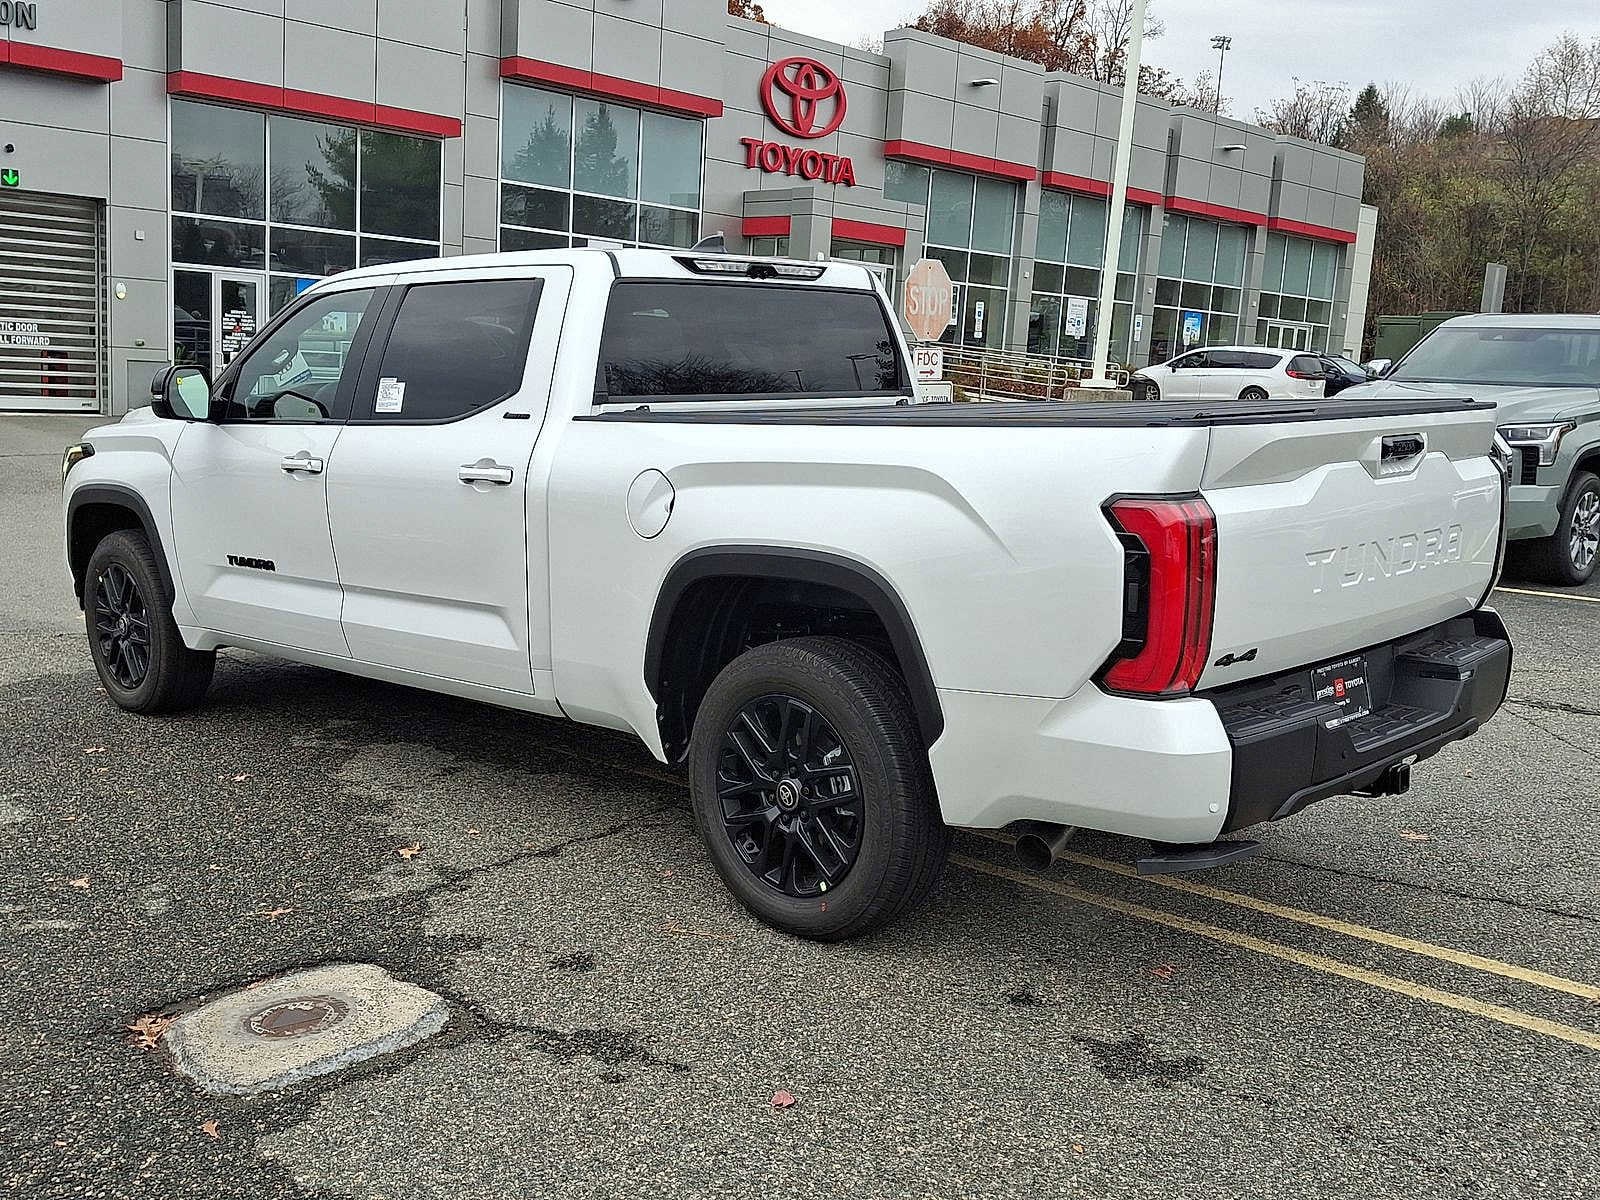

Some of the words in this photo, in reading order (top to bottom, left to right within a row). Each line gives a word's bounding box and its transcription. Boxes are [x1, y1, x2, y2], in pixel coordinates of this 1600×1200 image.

[740, 137, 856, 187] TOYOTA
[908, 286, 949, 317] STOP
[15, 323, 38, 332] DOOR
[11, 336, 50, 345] FORWARD
[917, 352, 939, 366] FDC
[226, 554, 276, 572] TUNDRA
[1305, 524, 1463, 594] TUNDRA
[1345, 676, 1364, 689] TOYOTA
